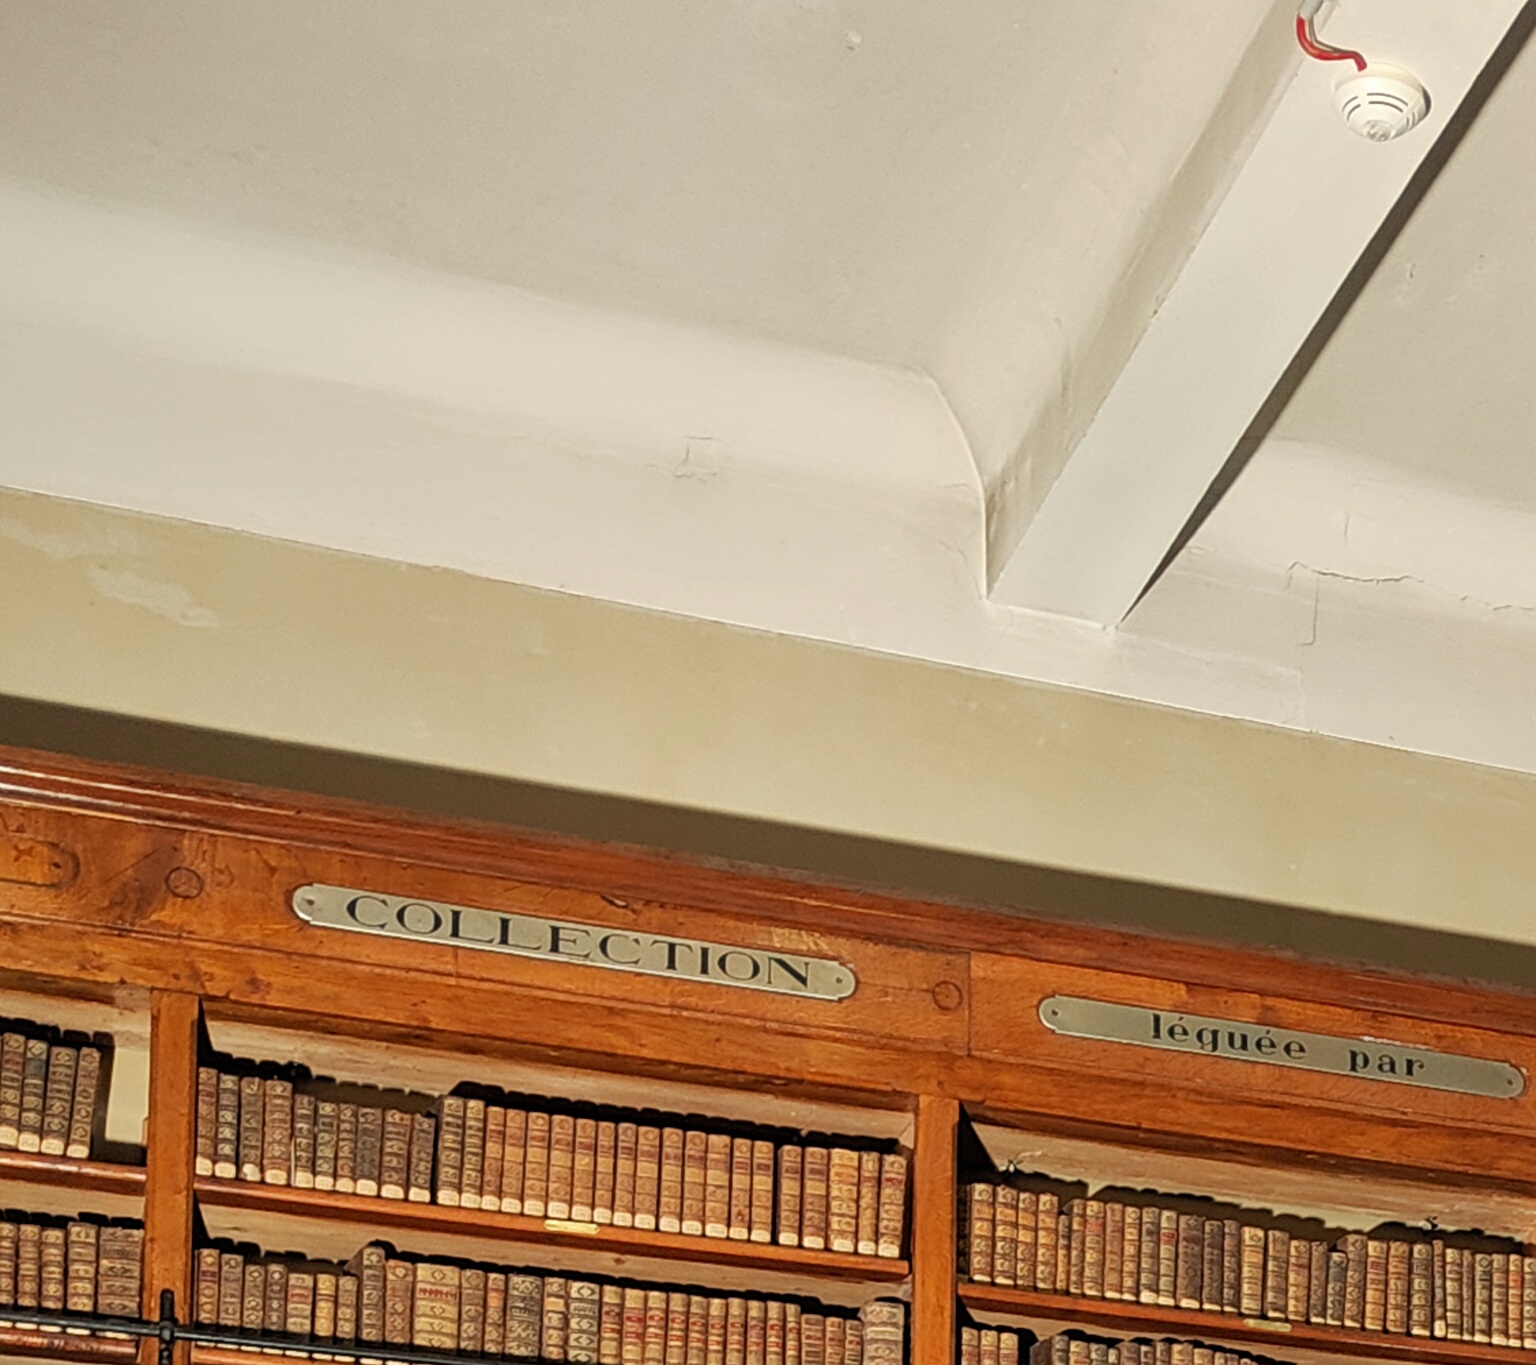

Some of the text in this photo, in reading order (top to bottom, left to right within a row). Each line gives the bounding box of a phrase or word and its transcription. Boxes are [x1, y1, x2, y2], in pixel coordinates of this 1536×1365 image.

[345, 894, 812, 990] COLLECTION
[1150, 1013, 1426, 1078] léguée par
